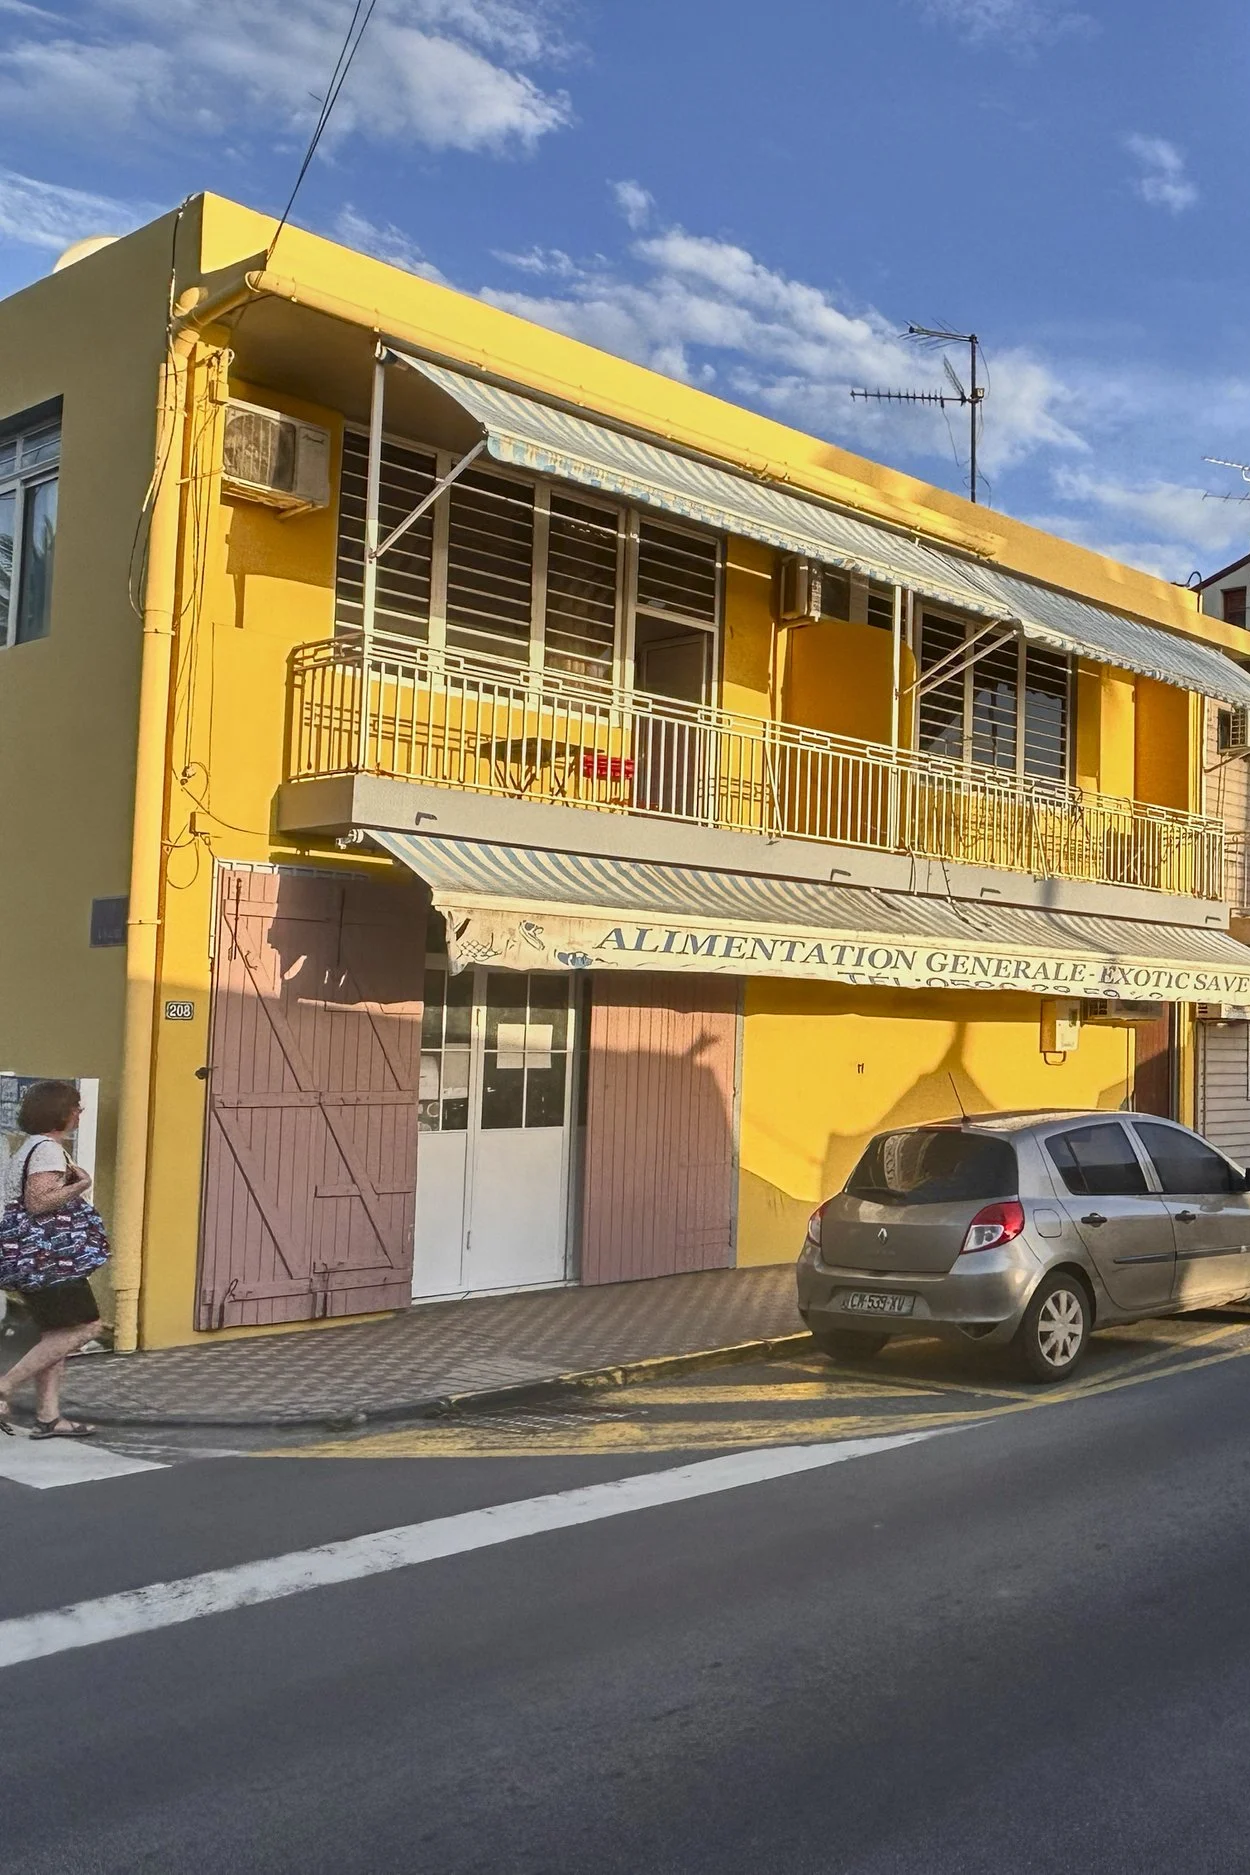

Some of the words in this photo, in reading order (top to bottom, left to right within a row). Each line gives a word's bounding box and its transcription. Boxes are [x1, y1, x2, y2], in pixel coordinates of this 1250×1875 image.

[593, 927, 916, 970] ALIMENTATION
[1098, 965, 1191, 991] EXOTIC
[169, 1004, 191, 1017] 208
